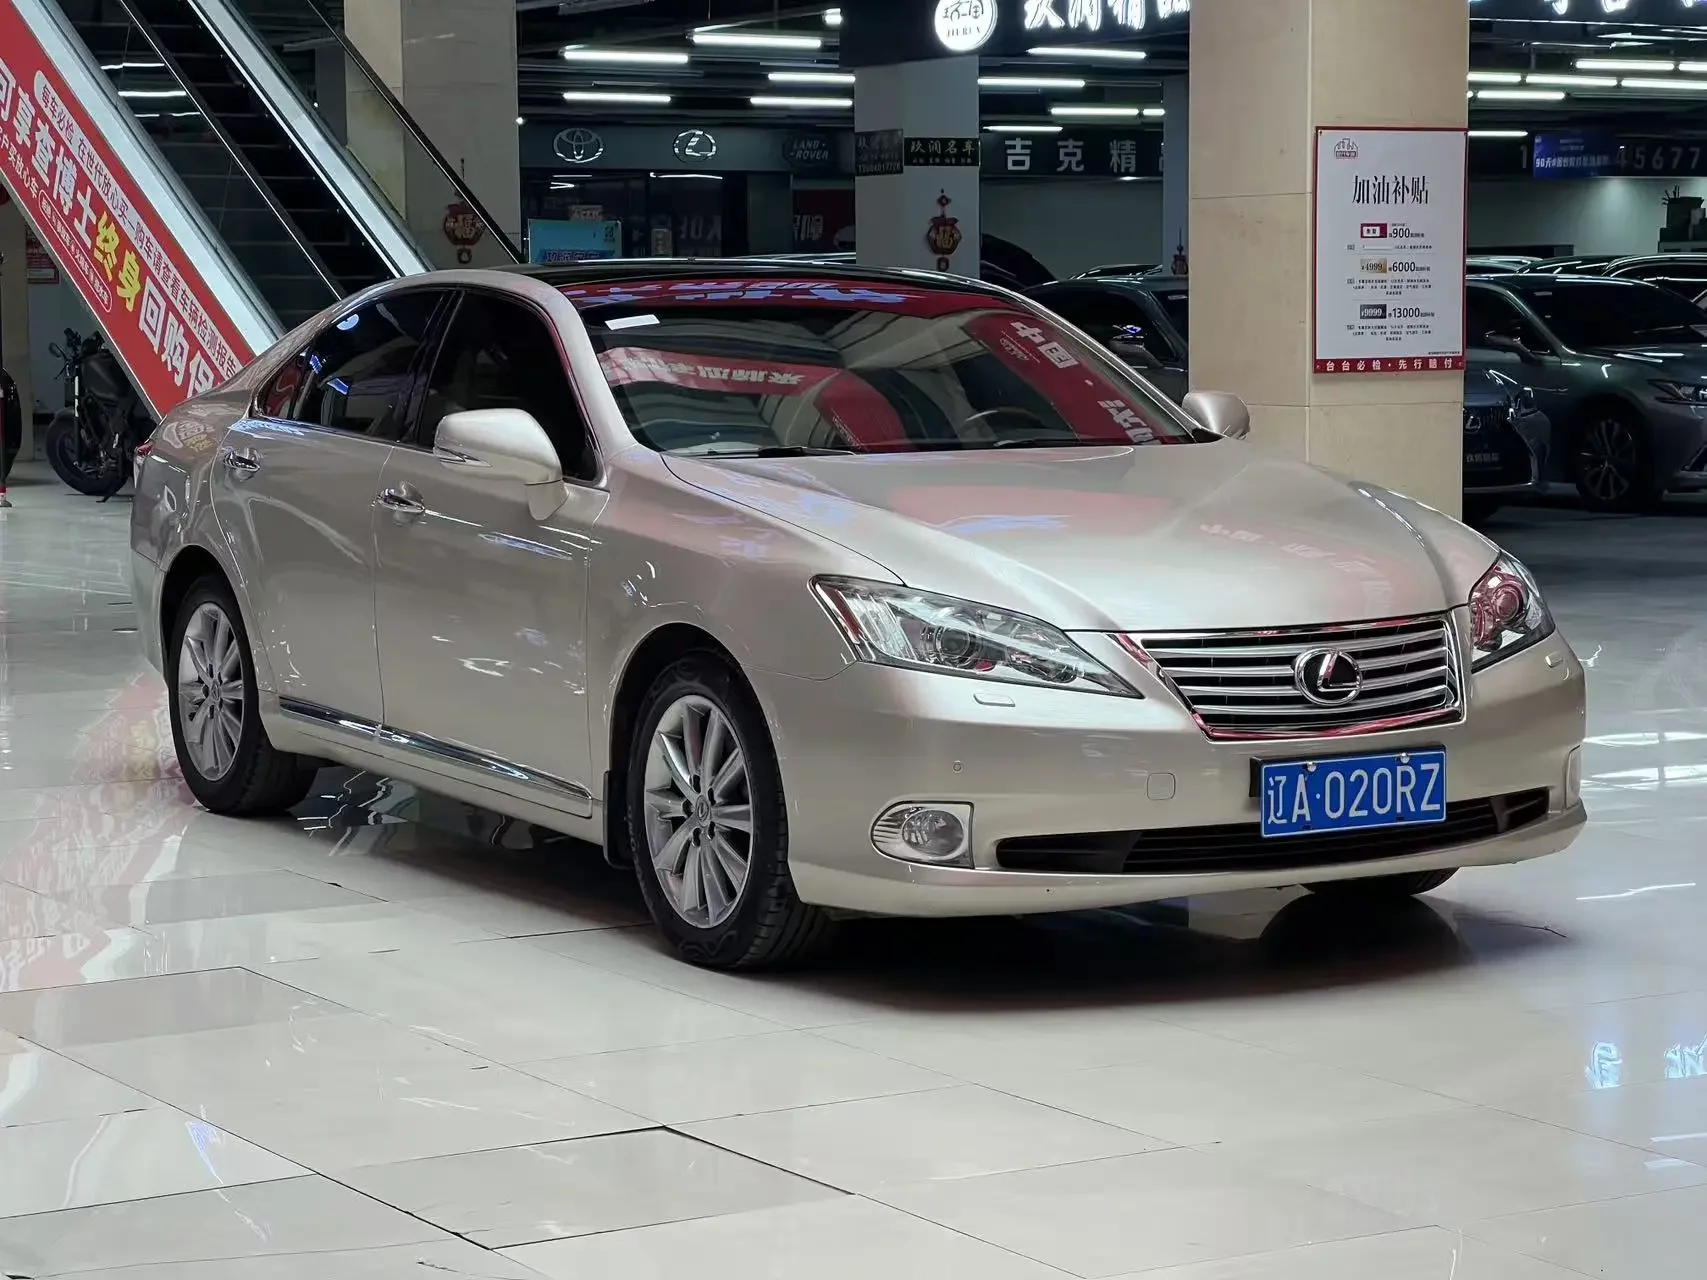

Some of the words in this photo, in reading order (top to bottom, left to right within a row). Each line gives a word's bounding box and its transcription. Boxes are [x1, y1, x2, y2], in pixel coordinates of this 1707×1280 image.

[793, 140, 820, 149] LAND
[796, 149, 829, 160] ROVER
[1004, 137, 1164, 173] 吉克精
[1351, 175, 1430, 205] 加油补贴
[1392, 227, 1410, 238] 900
[1392, 261, 1416, 272] 6000
[1392, 307, 1420, 318] 13000
[1268, 763, 1440, 824] 辽A·020RZ
